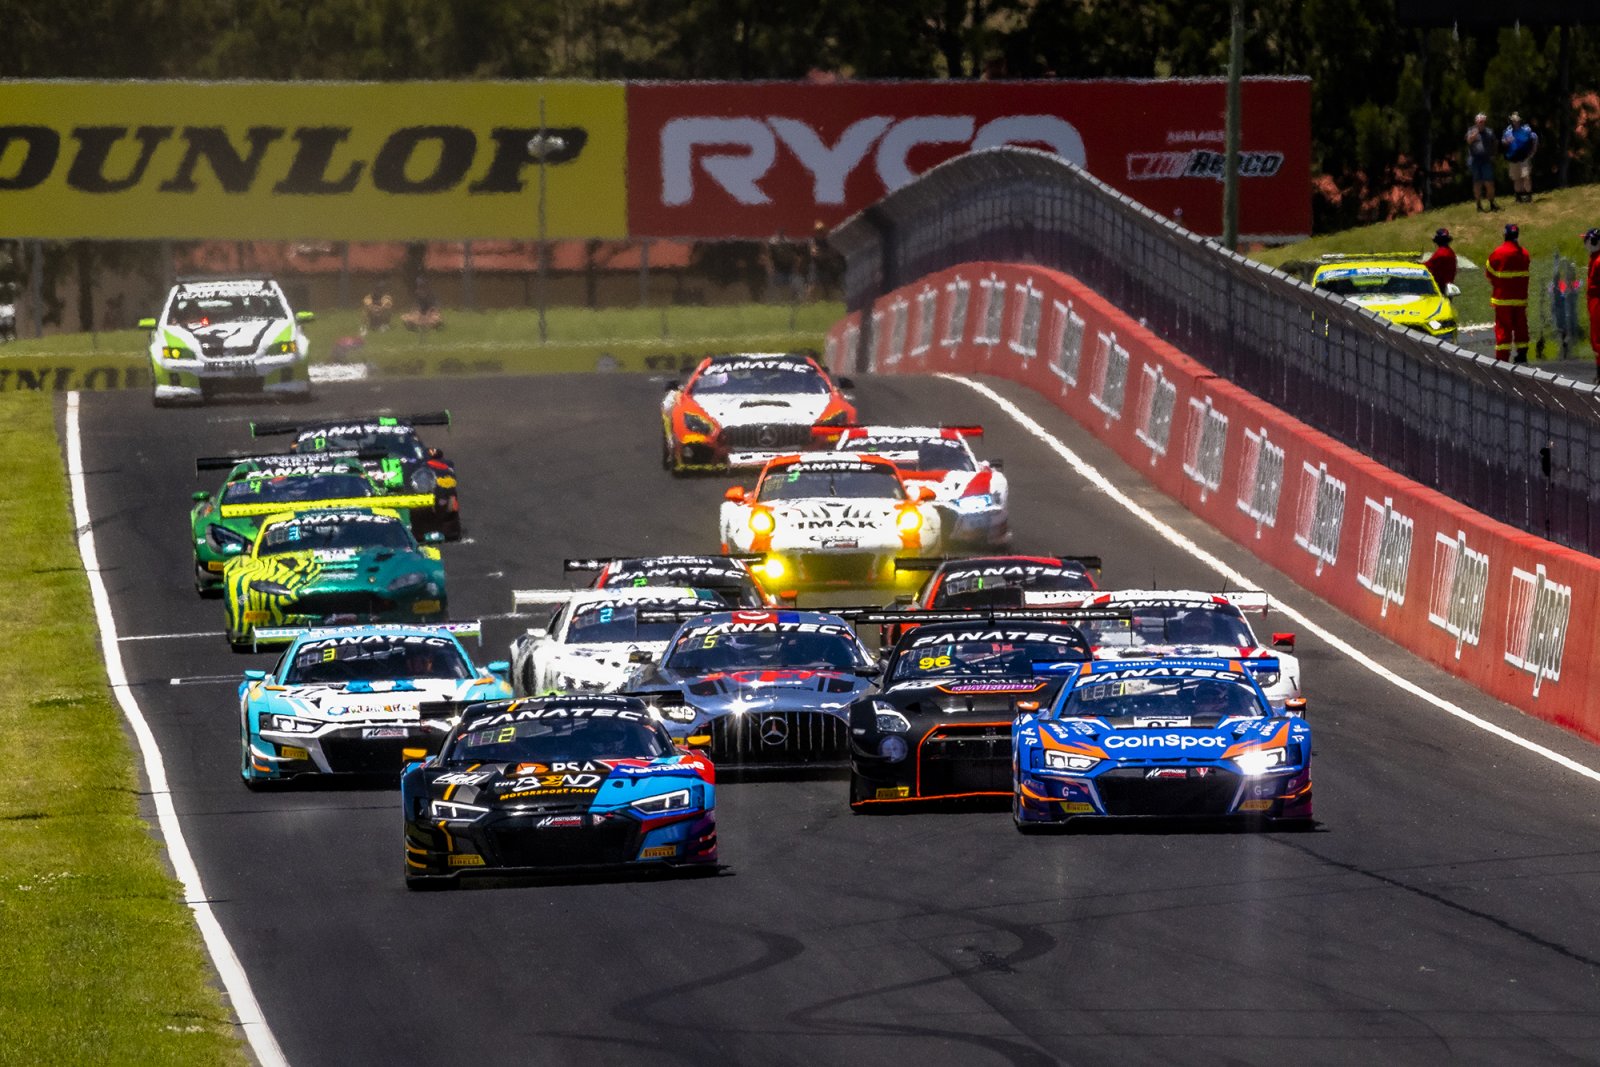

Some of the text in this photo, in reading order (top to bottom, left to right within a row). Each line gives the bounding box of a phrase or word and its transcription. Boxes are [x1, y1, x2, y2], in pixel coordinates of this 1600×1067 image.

[703, 361, 809, 375] FANATEC
[846, 436, 960, 449] FANATEC
[246, 464, 350, 480] FANATEC
[787, 463, 874, 473] FANATEC
[265, 514, 396, 531] FANATEC
[607, 566, 743, 585] FANATEC
[946, 566, 1081, 582] FANATEC
[576, 598, 717, 615] FANATEC
[1106, 599, 1215, 610] FANATEC
[992, 610, 1119, 620] Distribution
[688, 622, 841, 639] FANATEC
[297, 635, 445, 655] FANATEC
[702, 635, 717, 649] 5
[912, 631, 1072, 648] FANATEC
[322, 647, 336, 662] 3
[918, 655, 951, 670] 96
[1074, 667, 1239, 689] FANATEC
[467, 707, 643, 731] FANATEC
[497, 726, 515, 743] 2
[1104, 733, 1227, 750] CoinSpot
[619, 761, 705, 775] Valvoline
[499, 787, 598, 801] MOTORSPORT PARK
